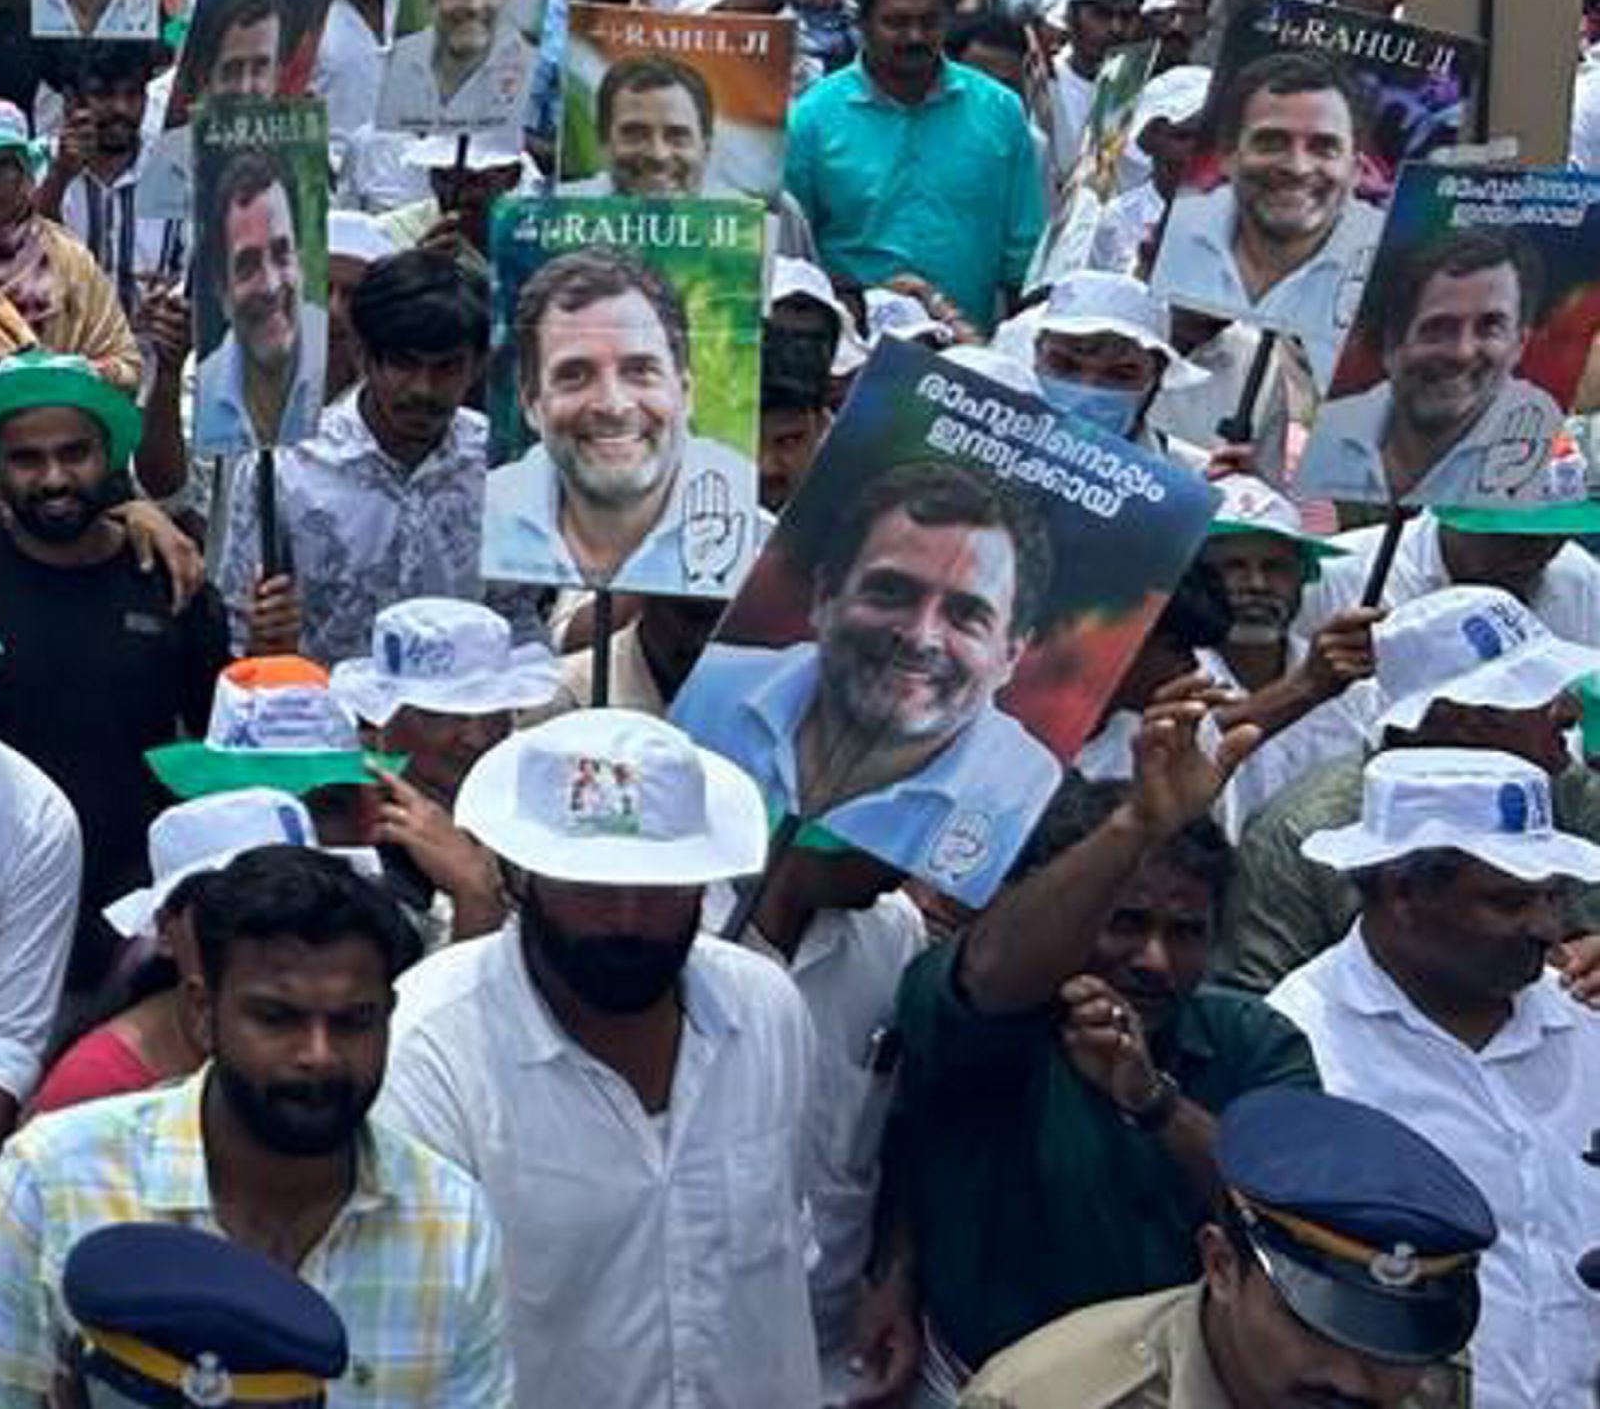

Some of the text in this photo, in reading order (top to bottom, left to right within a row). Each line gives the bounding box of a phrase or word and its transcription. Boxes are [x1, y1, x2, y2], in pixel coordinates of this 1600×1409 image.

[625, 24, 770, 56] RAHUL JI
[1302, 16, 1422, 69] RAHUL
[1425, 45, 1456, 77] JI
[564, 212, 702, 248] RAHUL
[708, 215, 740, 248] JI
